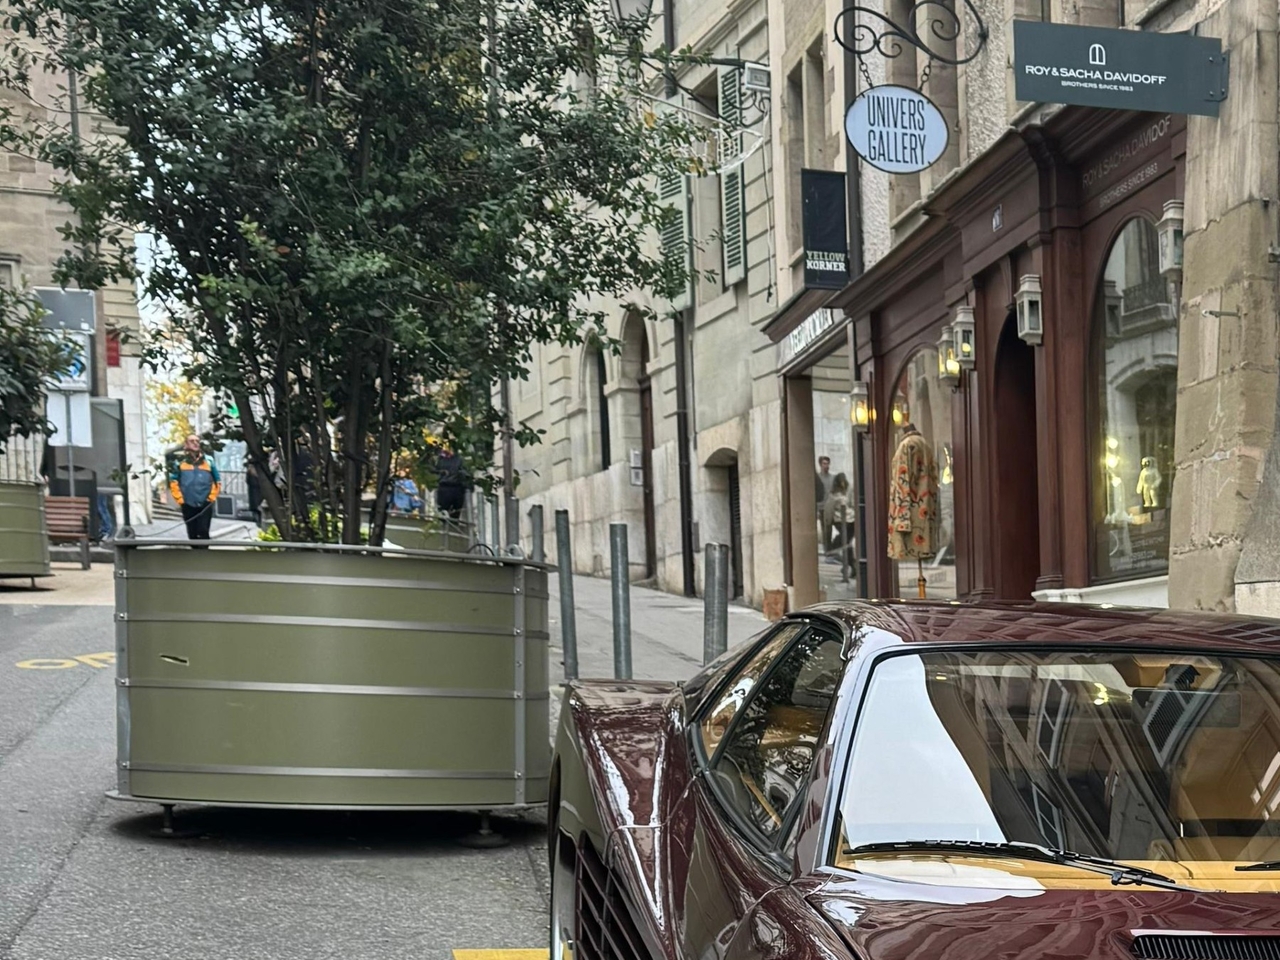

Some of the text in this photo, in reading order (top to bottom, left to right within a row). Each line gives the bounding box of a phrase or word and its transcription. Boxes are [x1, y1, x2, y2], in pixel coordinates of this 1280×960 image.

[1103, 71, 1167, 85] DAVIDOFF
[1061, 80, 1098, 89] BROTHERS
[1098, 83, 1118, 91] SINCE
[867, 94, 926, 131] UNIVERS
[867, 129, 926, 166] GALLERY
[806, 250, 846, 261] YELLOW
[806, 259, 847, 272] KORNER
